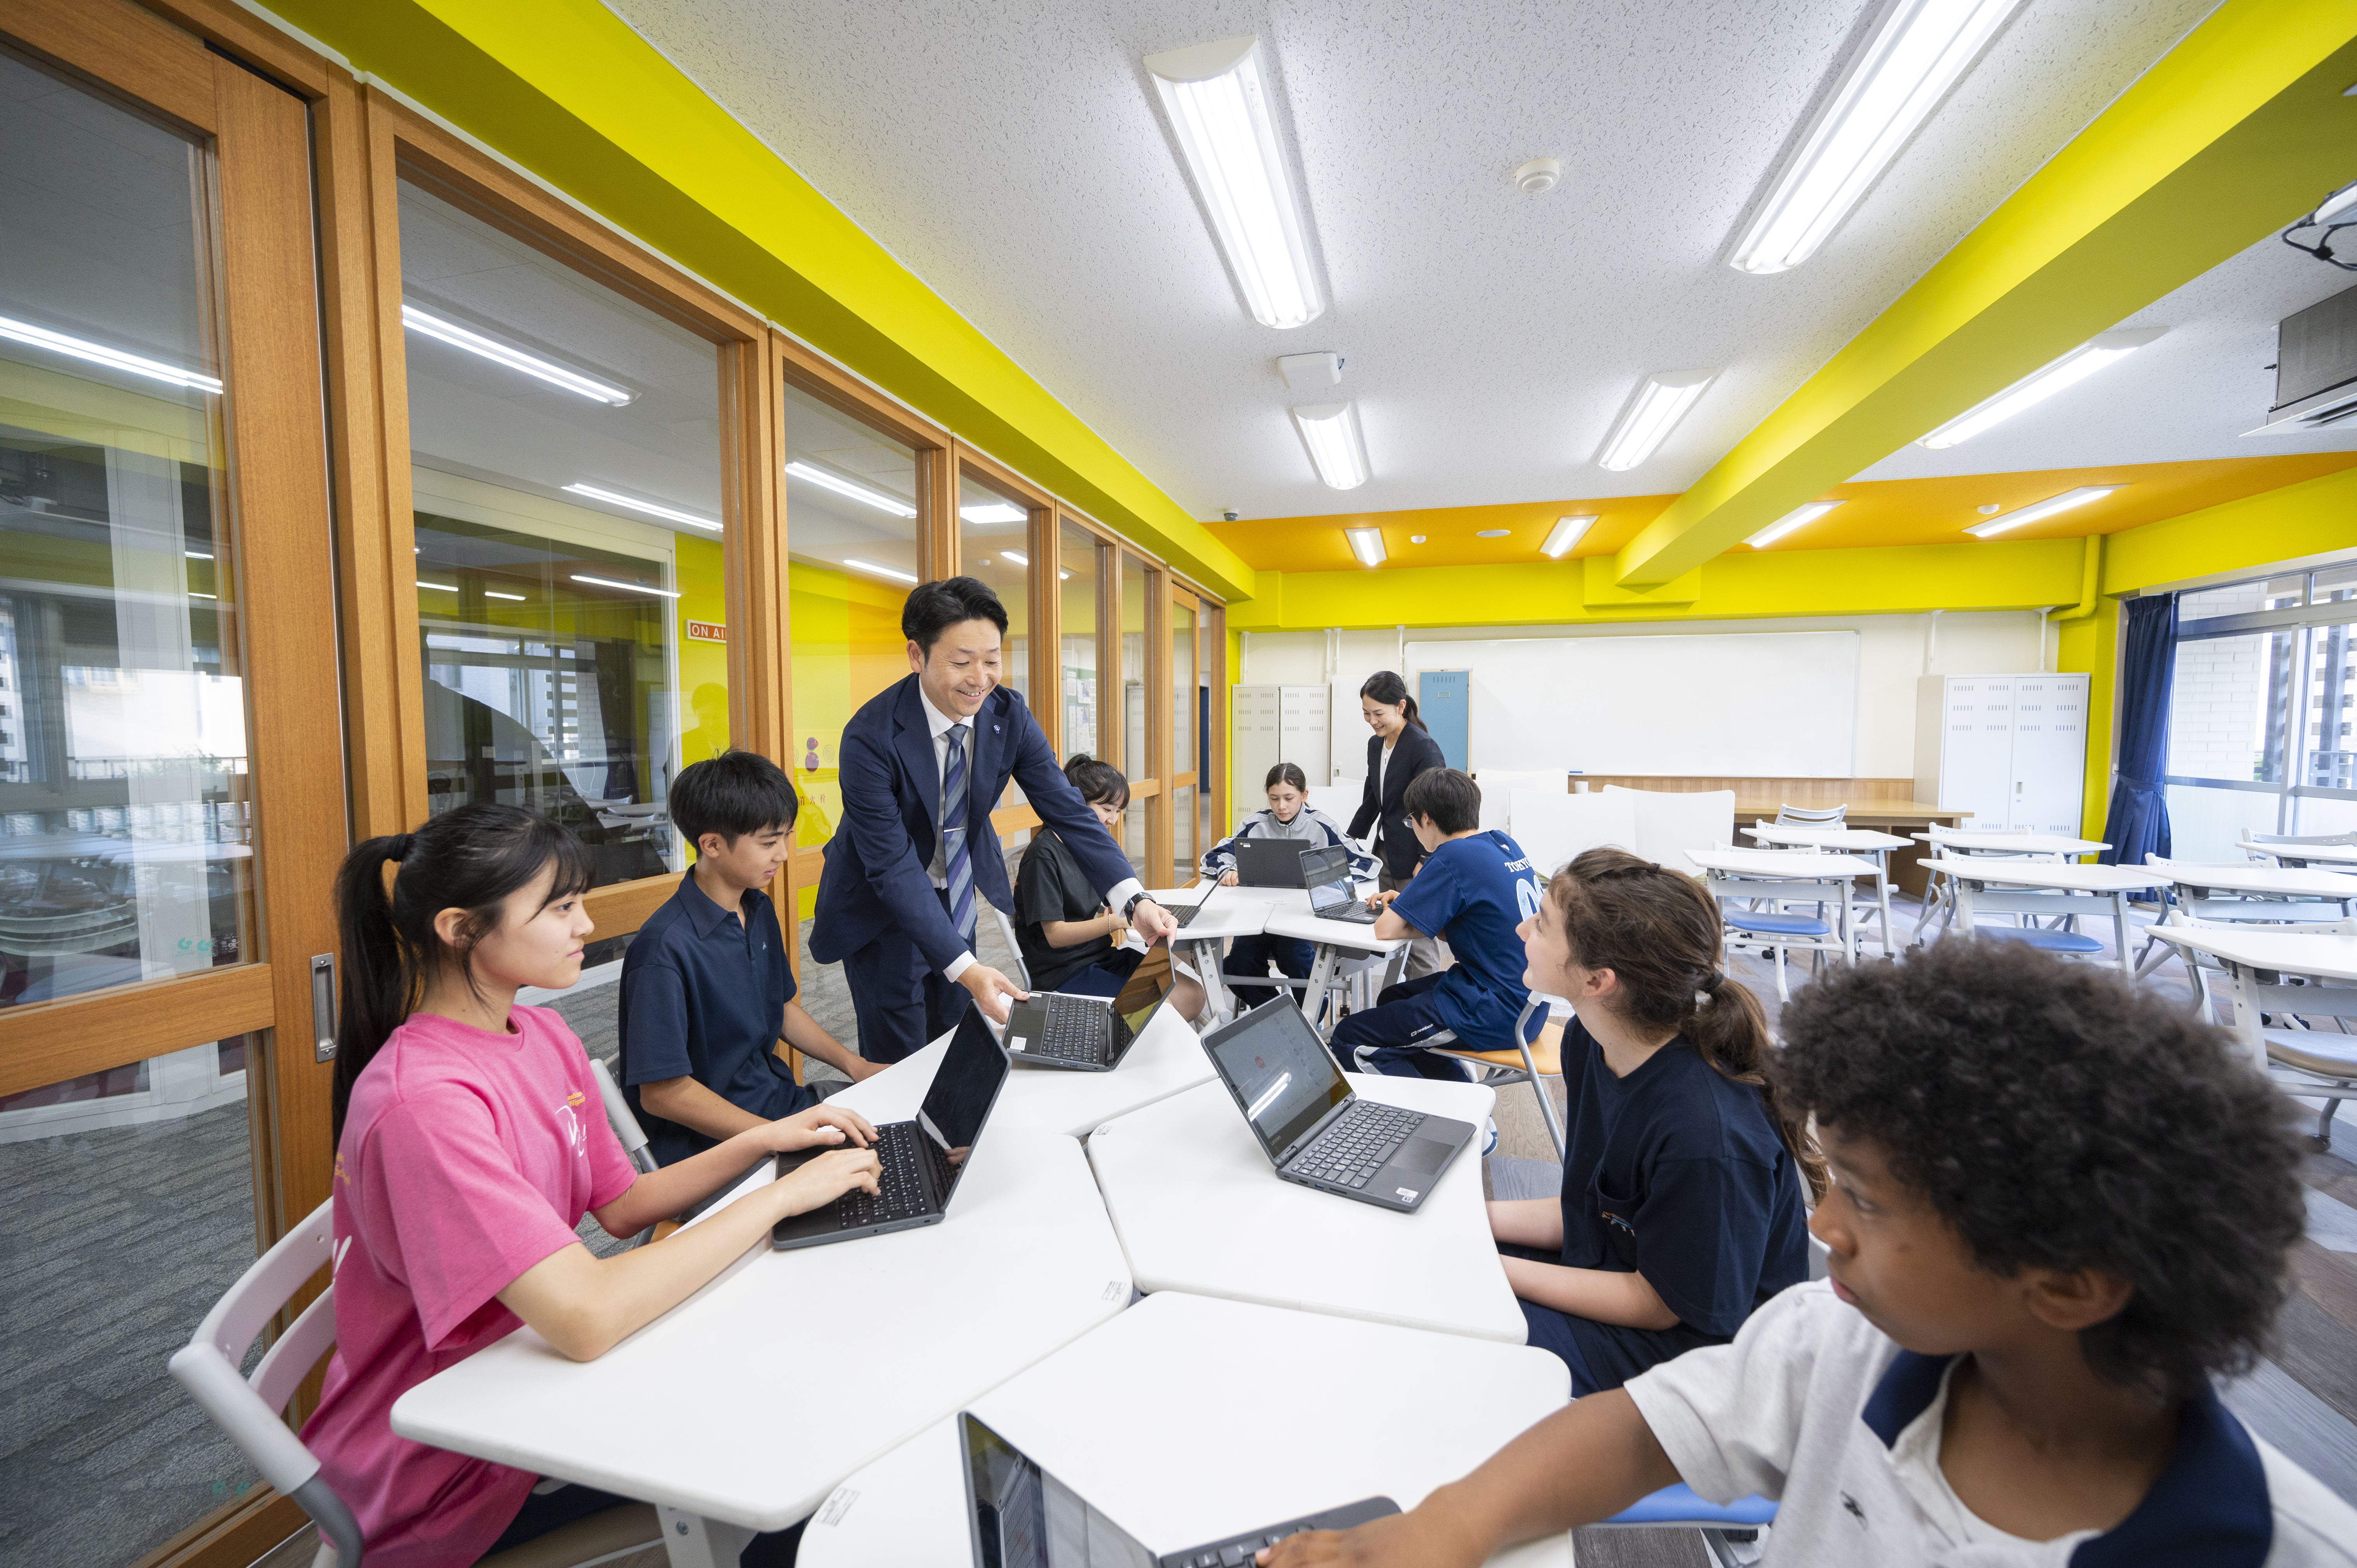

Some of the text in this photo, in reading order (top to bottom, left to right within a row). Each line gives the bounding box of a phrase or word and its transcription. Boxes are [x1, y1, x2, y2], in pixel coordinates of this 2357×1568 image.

[692, 625, 726, 639] ON AI
[799, 794, 826, 806] 消火栓
[1504, 857, 1531, 872] TOKYO
[1417, 1023, 1434, 1033] reebok
[1270, 1135, 1281, 1146] Lenovo
